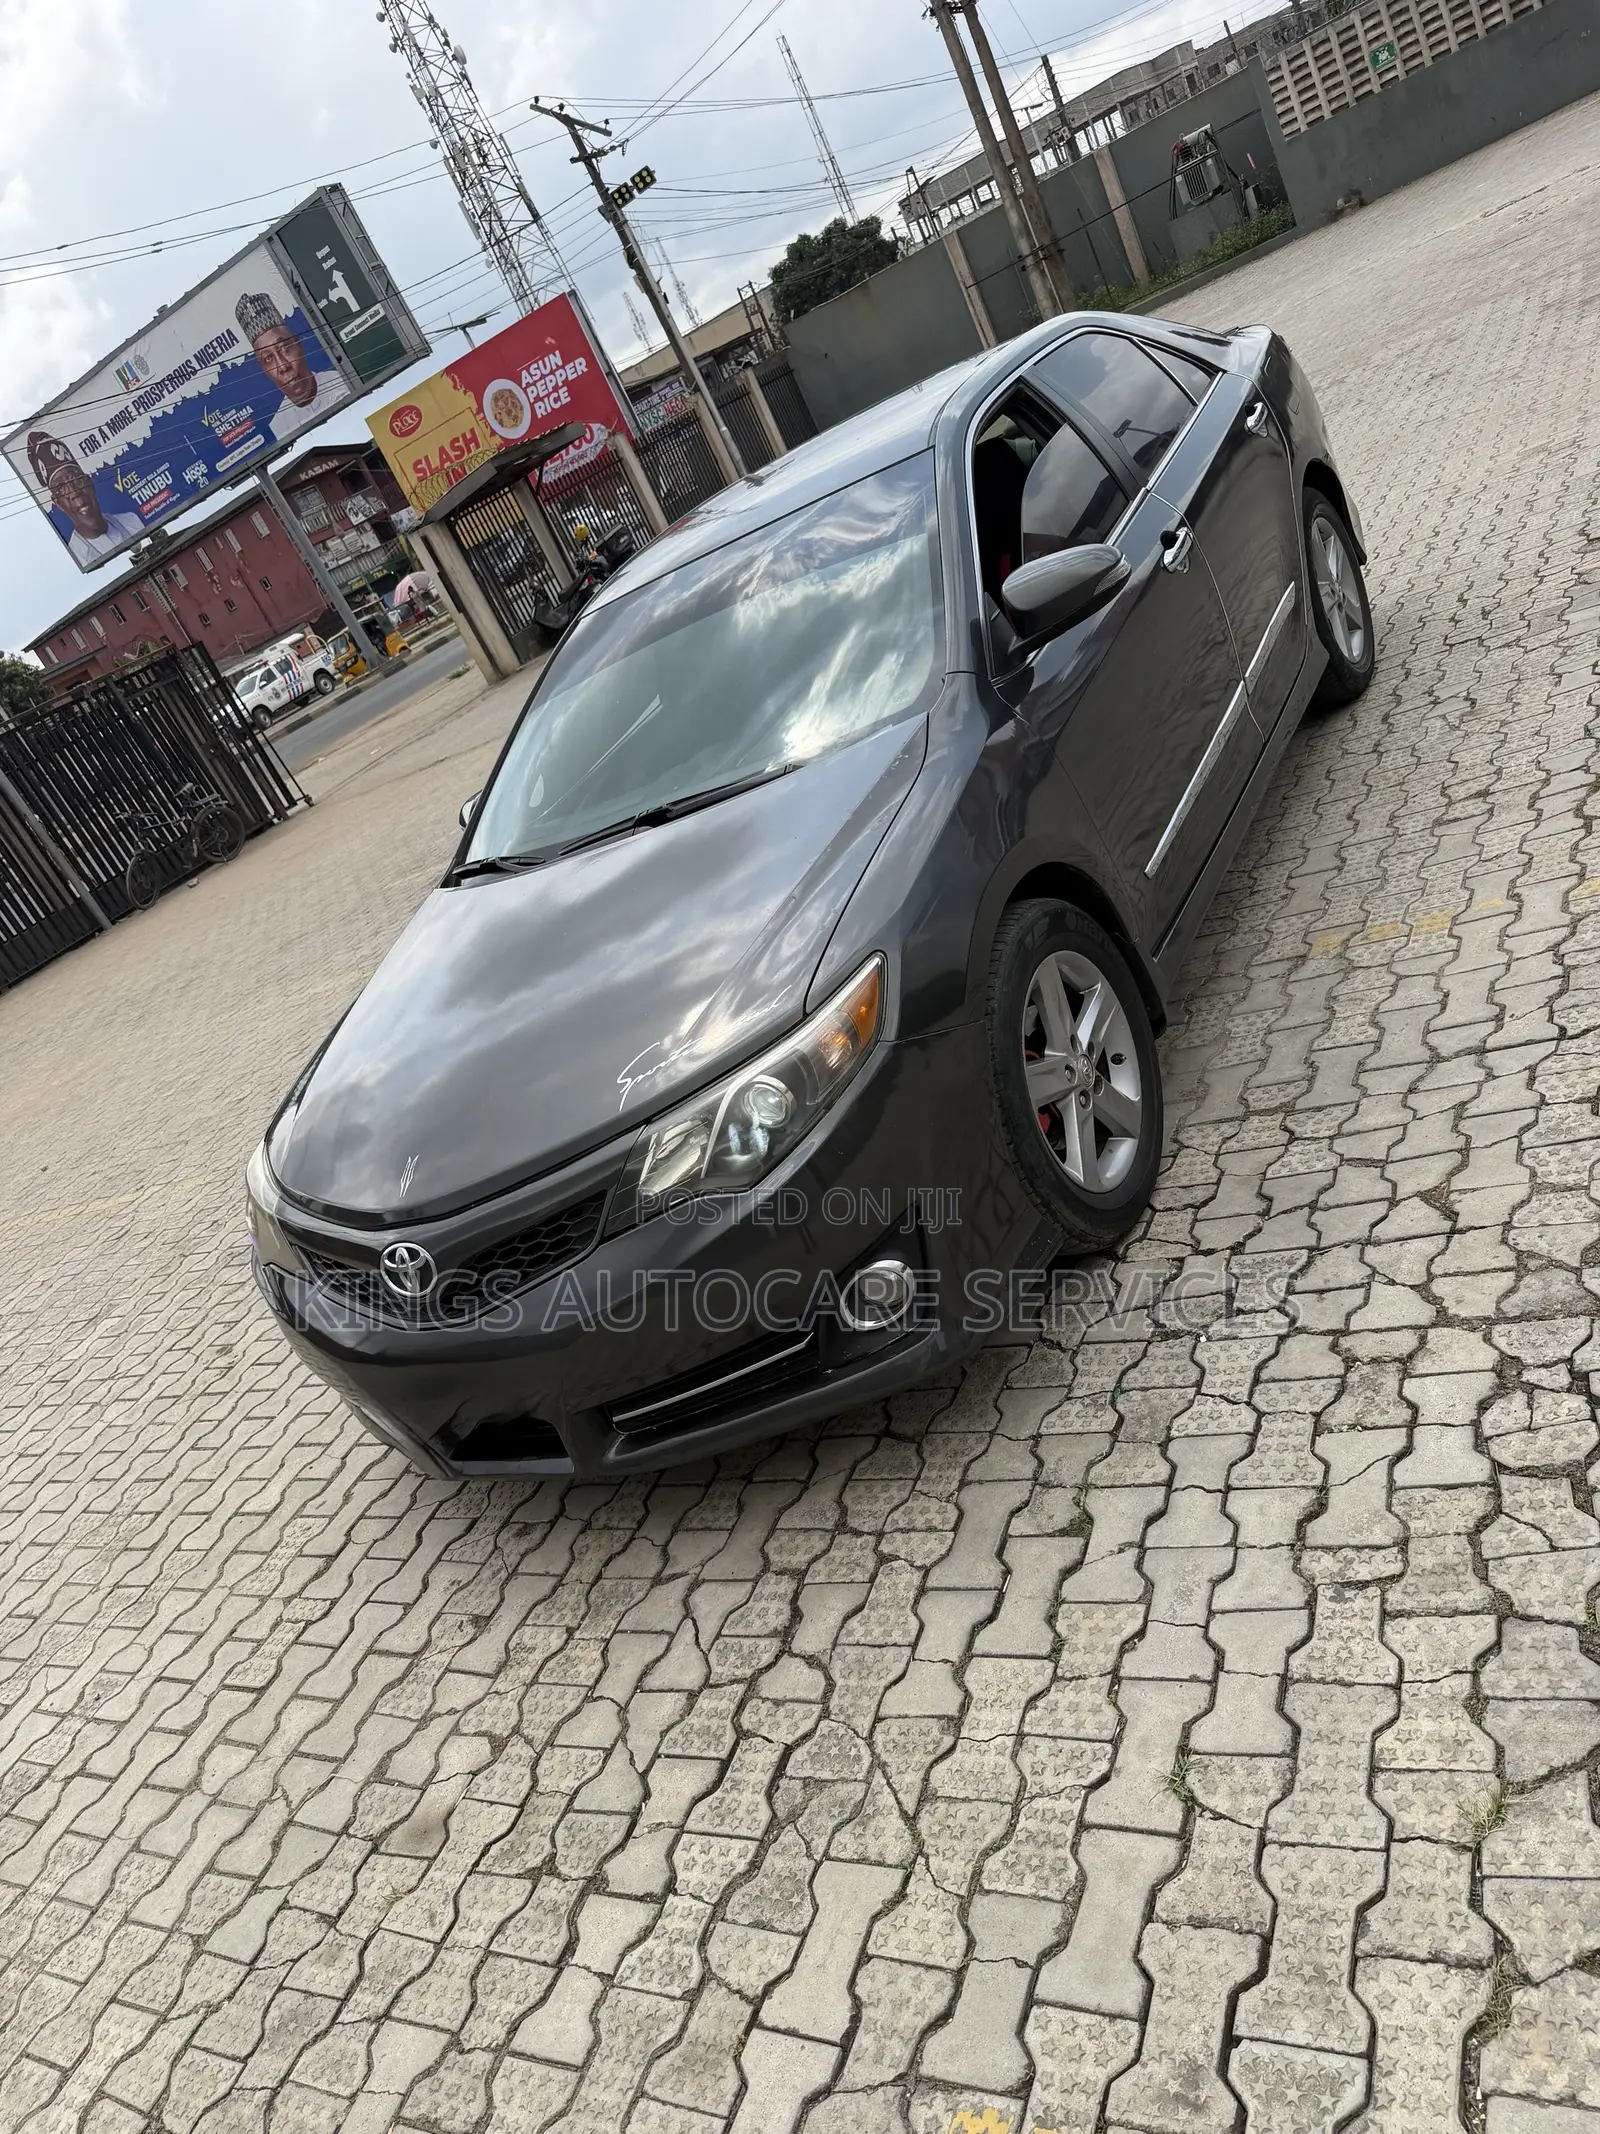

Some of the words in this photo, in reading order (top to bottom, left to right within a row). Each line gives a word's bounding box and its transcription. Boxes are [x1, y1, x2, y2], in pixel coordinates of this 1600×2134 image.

[521, 350, 563, 388] ASUN
[527, 357, 589, 403] PEPPER
[78, 436, 102, 458] FOR
[98, 427, 110, 445] A
[106, 404, 137, 437] MORE
[131, 364, 198, 417] PROSPEROUS
[193, 328, 240, 369] NIGERIA
[534, 388, 571, 419] RICE
[214, 405, 254, 437] SHETTIMA
[300, 459, 339, 480] KASAM
[412, 427, 481, 482] SLASH
[131, 470, 173, 505] TINUBU
